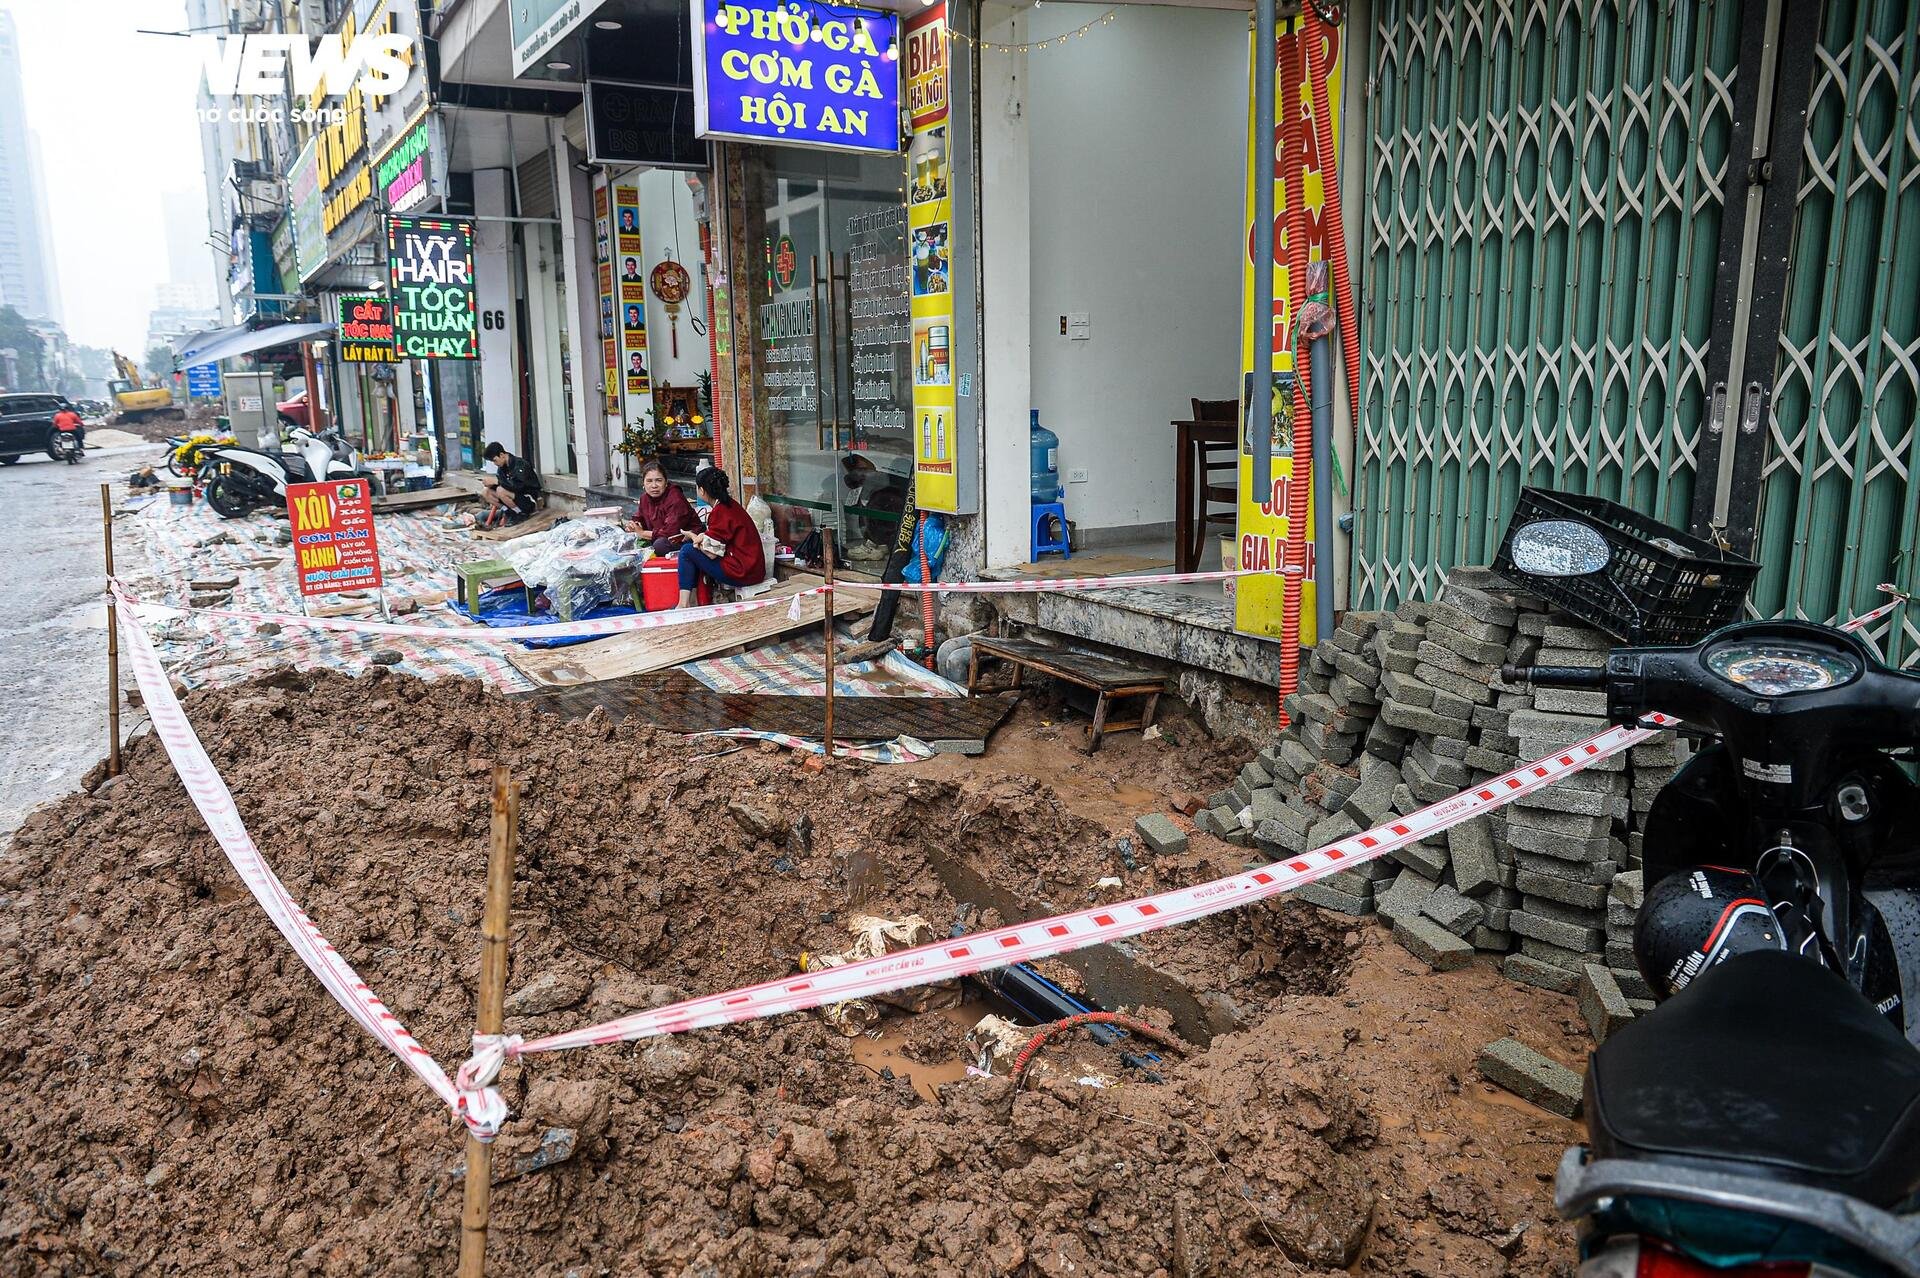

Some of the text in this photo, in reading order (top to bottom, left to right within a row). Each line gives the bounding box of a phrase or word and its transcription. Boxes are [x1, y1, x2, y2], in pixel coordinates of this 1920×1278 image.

[724, 3, 810, 45] PHỞ
[909, 26, 943, 79] BIA
[721, 49, 884, 99] CƠM GÀ
[909, 75, 944, 113] HÀ NỘI
[740, 92, 869, 136] HỘI AN
[405, 233, 457, 261] IVY
[397, 257, 470, 285] HAIR
[353, 299, 383, 321] CẮT
[401, 282, 466, 311] TÓC
[343, 320, 369, 338] TÓC
[483, 311, 505, 330] 66
[343, 342, 363, 361] LẤY
[363, 343, 385, 361] RÁY
[406, 336, 468, 358] CHAY
[294, 489, 330, 530] XÔI
[299, 532, 332, 545] CƠM
[301, 544, 337, 570] BÁNH
[1242, 535, 1270, 571] GIA
[305, 565, 374, 583] NƯỚC GIẢI KHÁT
[1668, 959, 1684, 980] HEAD
[1683, 950, 1706, 978] QUÂN
